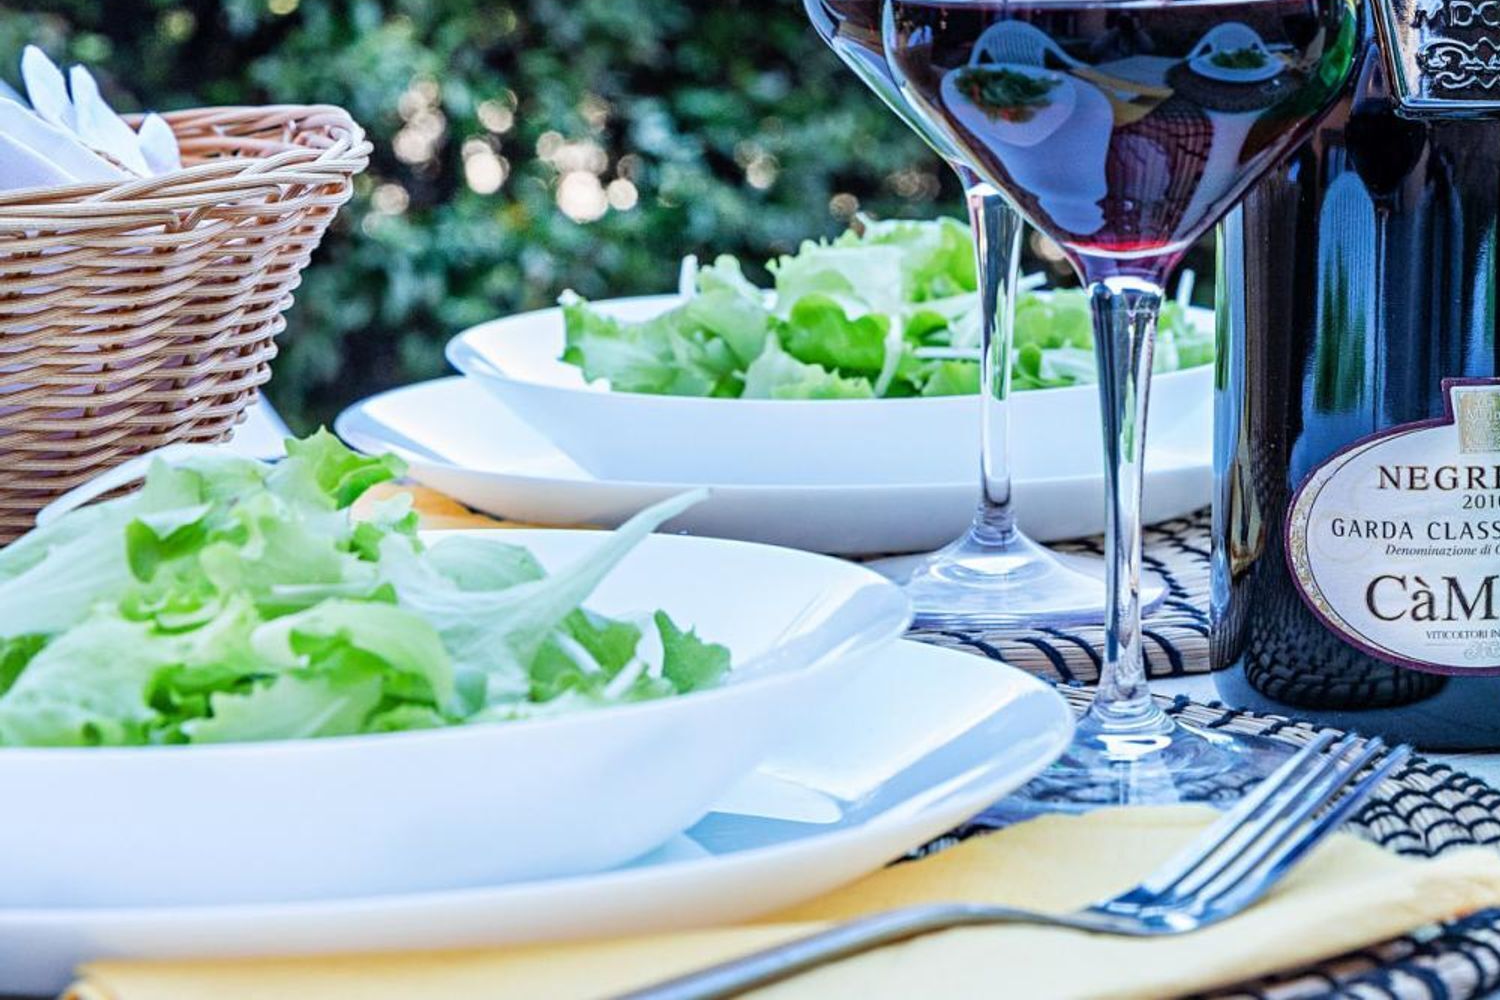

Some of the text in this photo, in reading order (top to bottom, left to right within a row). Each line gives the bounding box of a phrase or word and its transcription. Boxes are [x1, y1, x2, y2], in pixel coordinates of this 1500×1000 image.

[1331, 517, 1415, 541] GARDA
[1384, 543, 1477, 557] Denominazione
[1480, 543, 1491, 556] di
